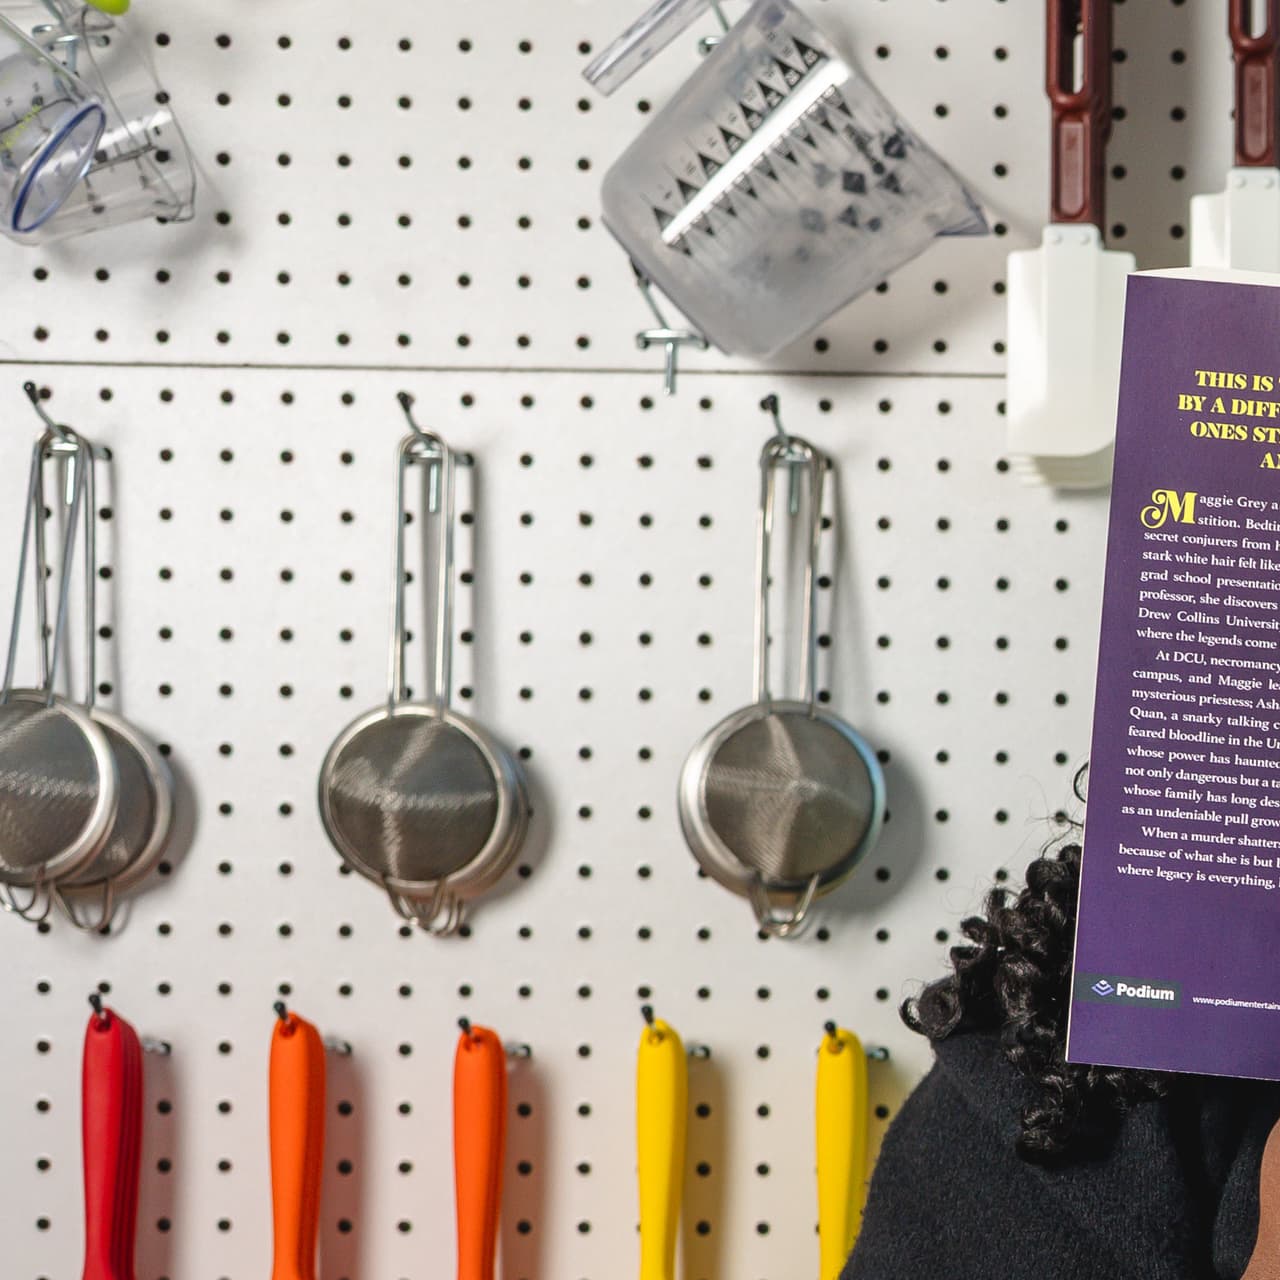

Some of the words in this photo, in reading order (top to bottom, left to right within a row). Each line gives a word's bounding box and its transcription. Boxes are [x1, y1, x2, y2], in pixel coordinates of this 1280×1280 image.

[1195, 370, 1247, 390] THIS
[1253, 374, 1273, 392] IS
[1178, 394, 1208, 413] BY
[1211, 396, 1226, 414] A
[1190, 421, 1247, 441] ONES
[1237, 496, 1268, 511] Grey
[1198, 517, 1240, 528] stition.
[1156, 650, 1170, 661] At
[1174, 652, 1207, 665] DCU,
[1122, 806, 1135, 814] as
[1138, 807, 1152, 816] an
[1156, 807, 1222, 823] undeniable
[1225, 813, 1248, 825] pull
[1116, 983, 1174, 1001] Podium
